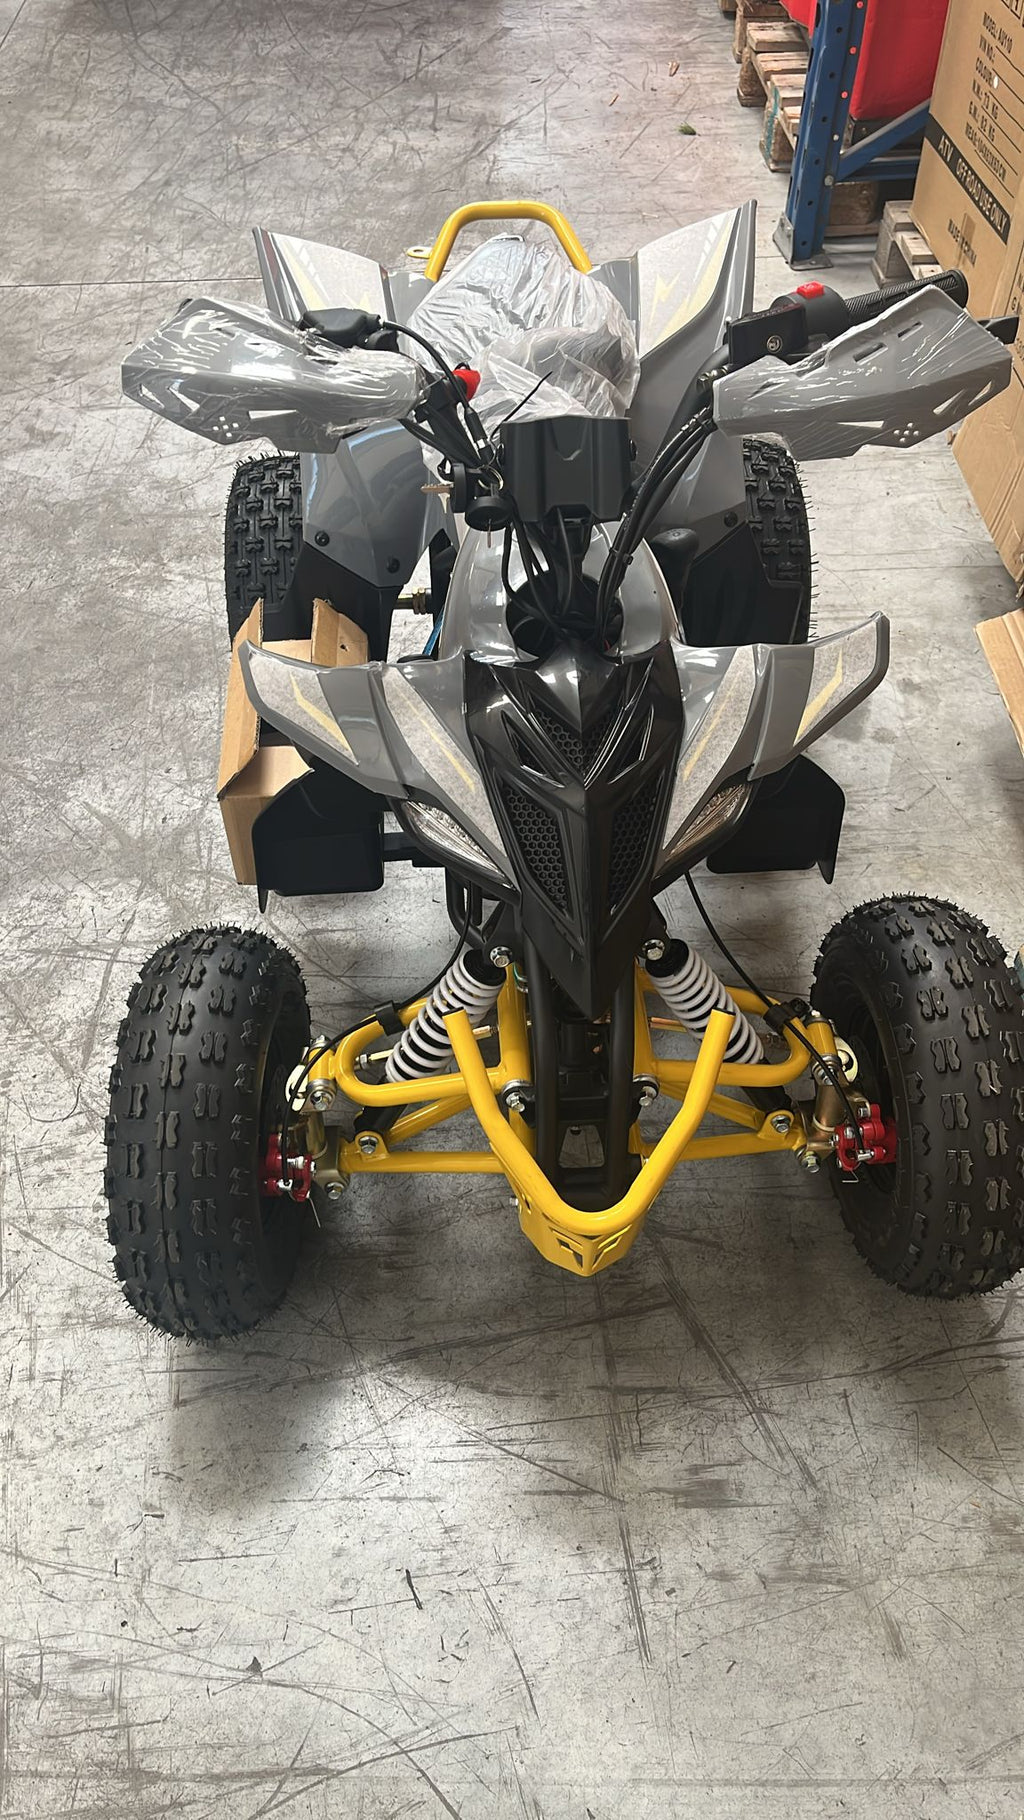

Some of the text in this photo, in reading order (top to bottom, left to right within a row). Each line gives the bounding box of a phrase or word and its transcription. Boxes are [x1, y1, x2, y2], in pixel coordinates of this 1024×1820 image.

[938, 135, 1007, 233] ATV OFF ROAD USE ONLY
